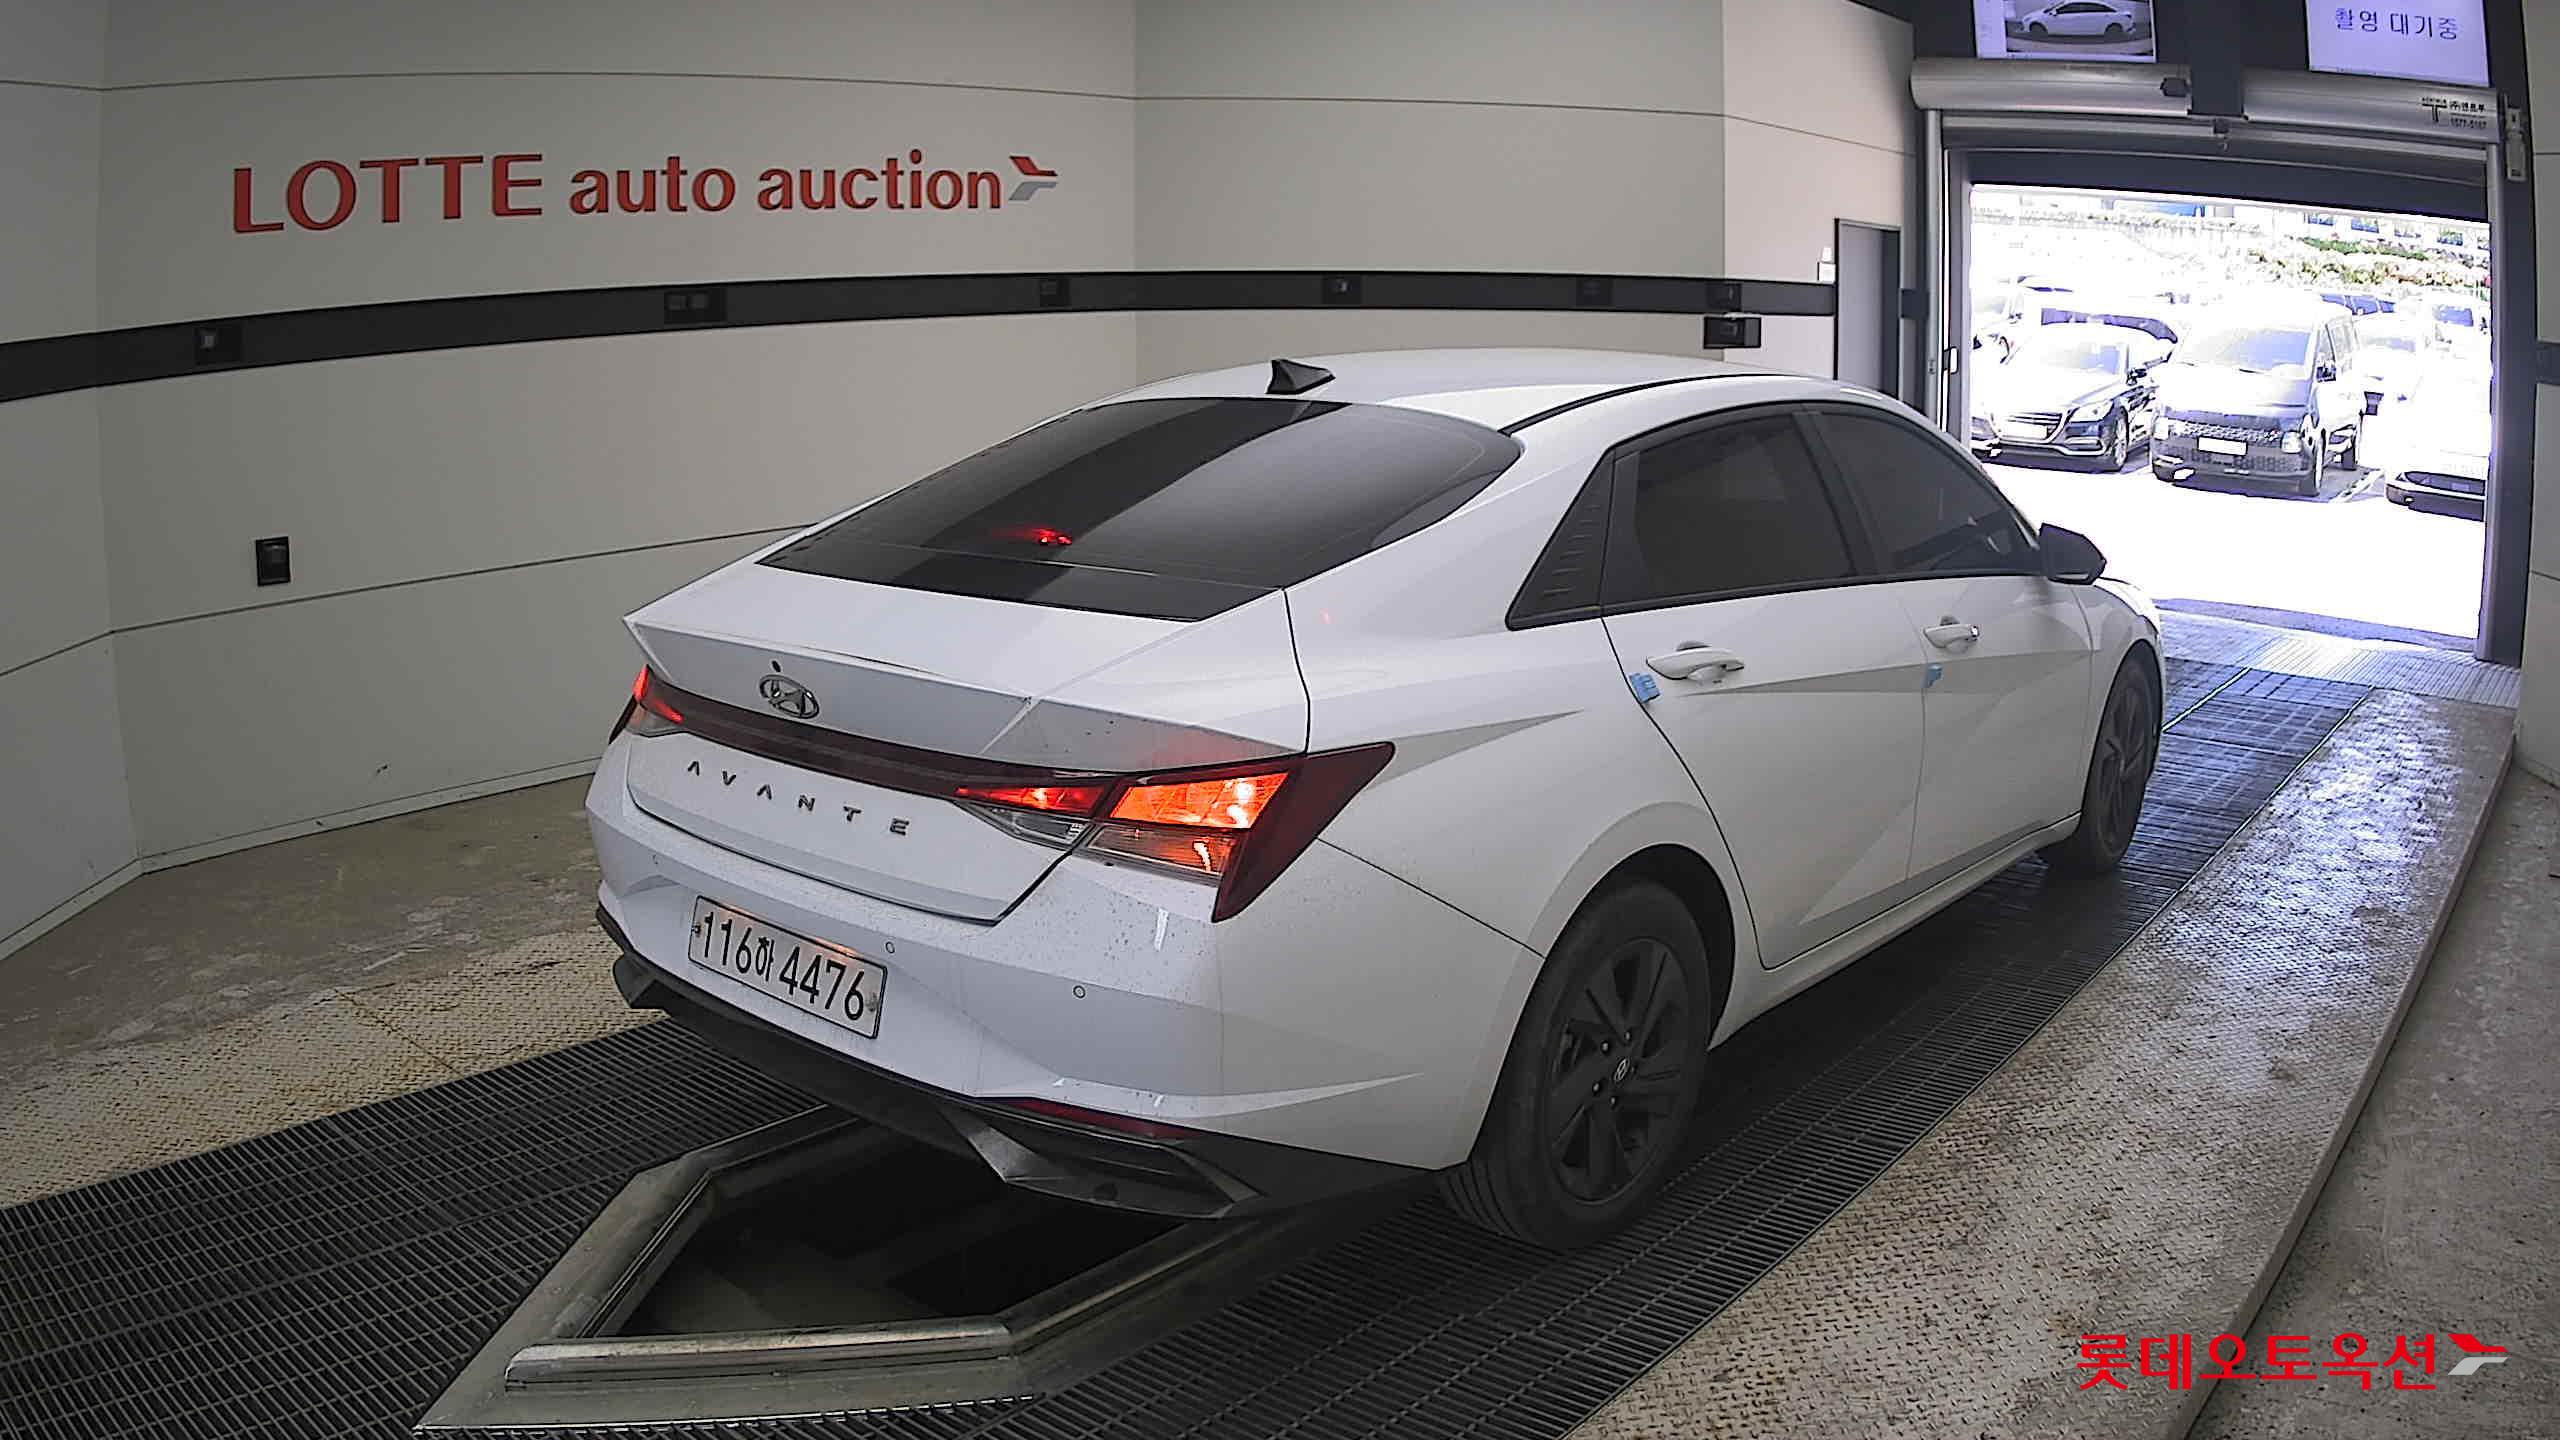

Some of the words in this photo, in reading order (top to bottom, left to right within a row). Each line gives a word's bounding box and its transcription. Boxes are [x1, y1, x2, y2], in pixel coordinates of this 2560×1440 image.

[2335, 7, 2378, 33] 촬영
[234, 154, 543, 233] LOTTE
[568, 156, 735, 214] auto
[757, 149, 1002, 210] auction
[687, 760, 910, 836] AVANTE
